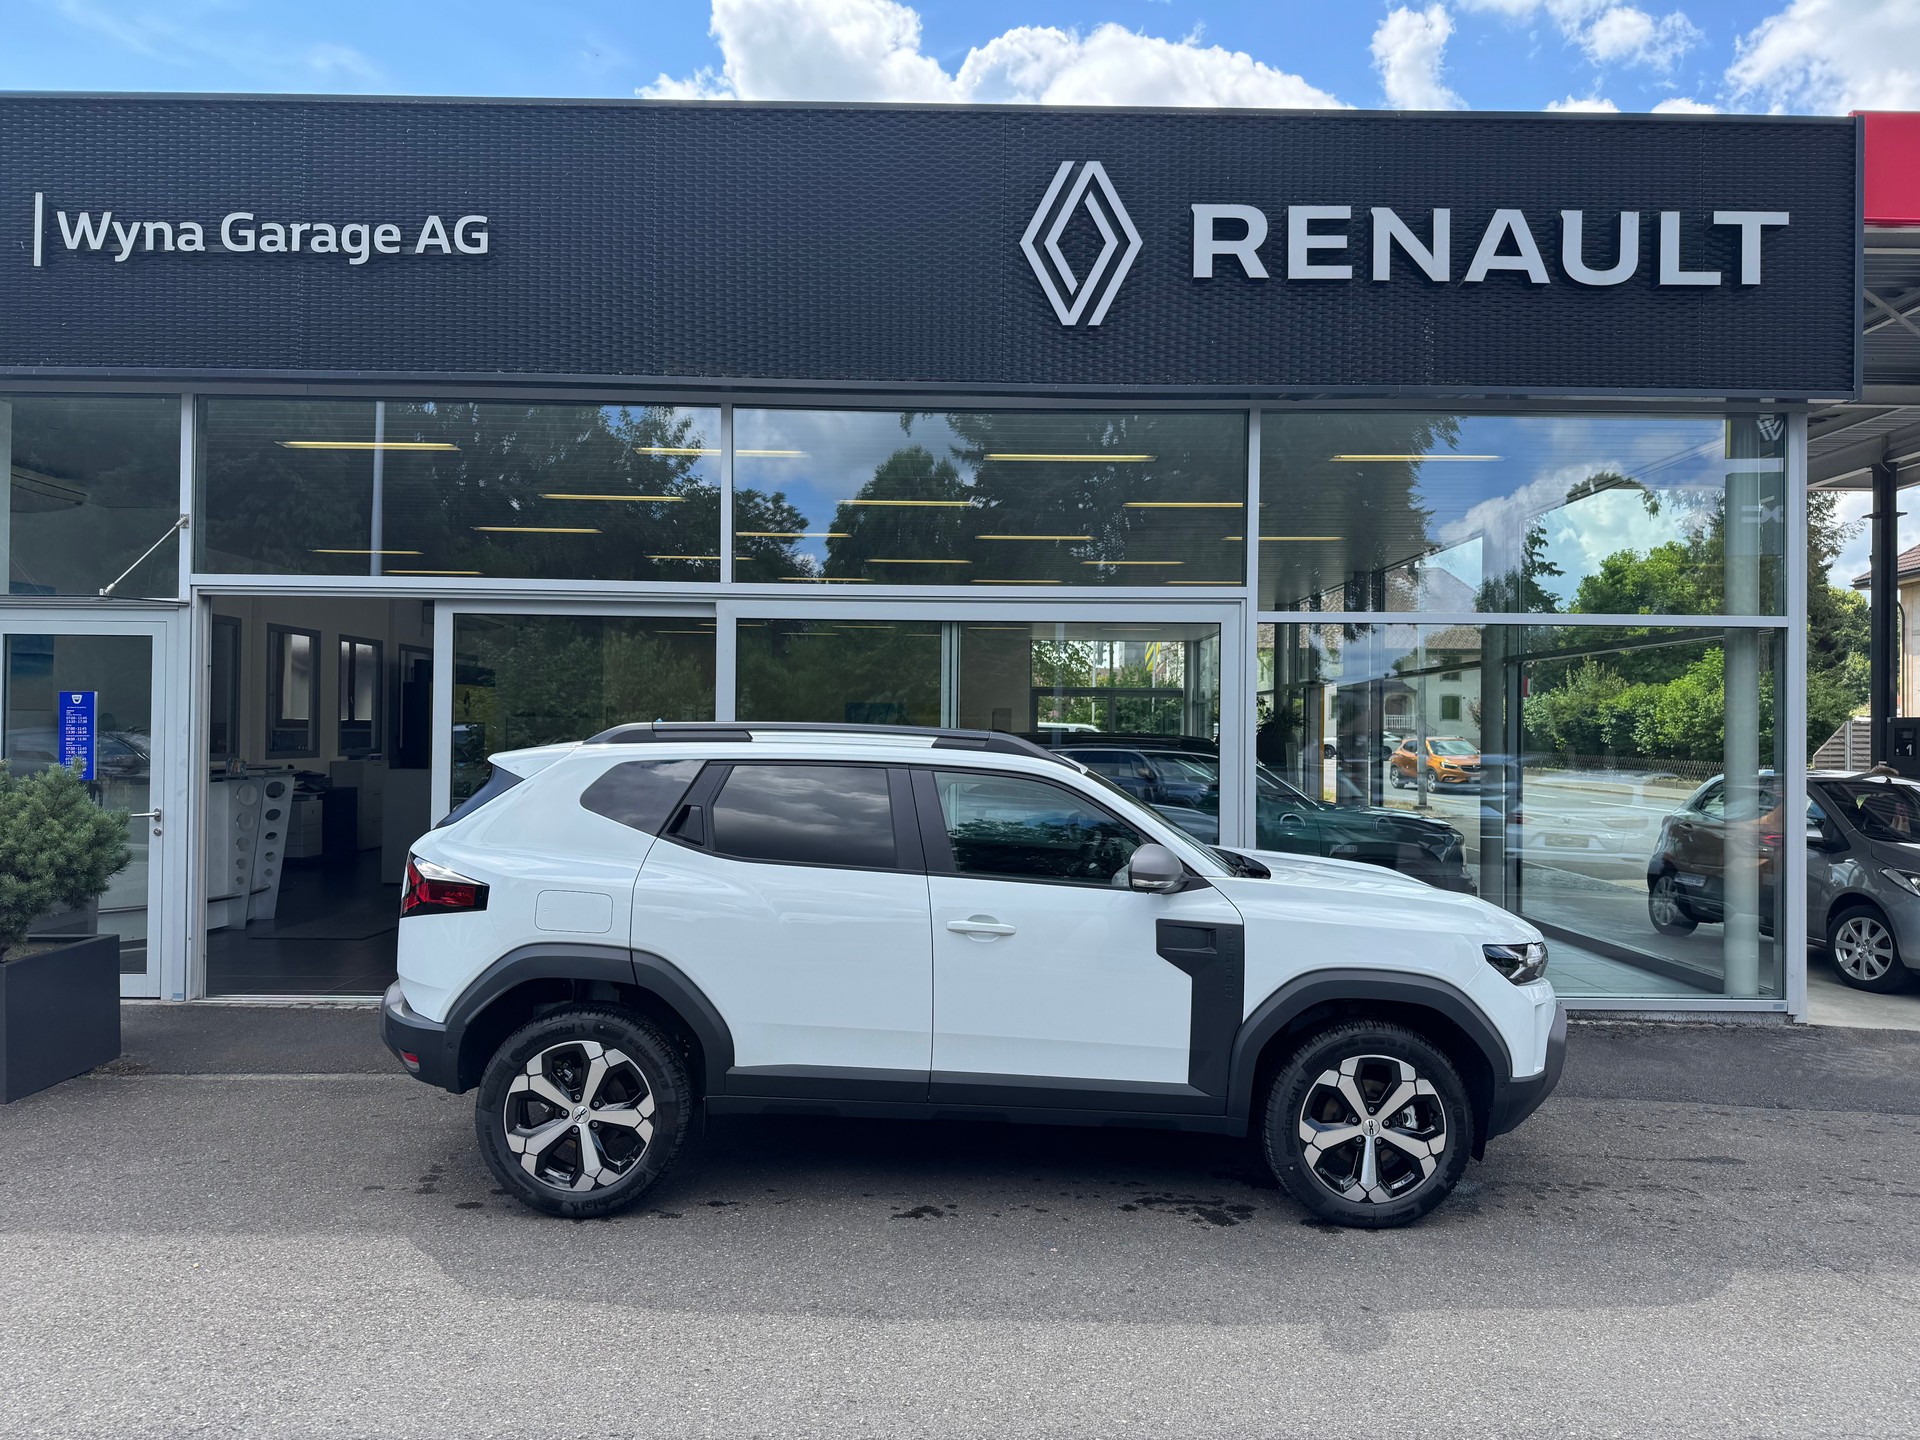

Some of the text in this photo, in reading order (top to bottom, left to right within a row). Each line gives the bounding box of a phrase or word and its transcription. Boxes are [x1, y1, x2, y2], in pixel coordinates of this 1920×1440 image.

[56, 210, 490, 266] Wyna Garage AG
[1191, 202, 1791, 287] RENAULT
[1905, 743, 1912, 756] 1
